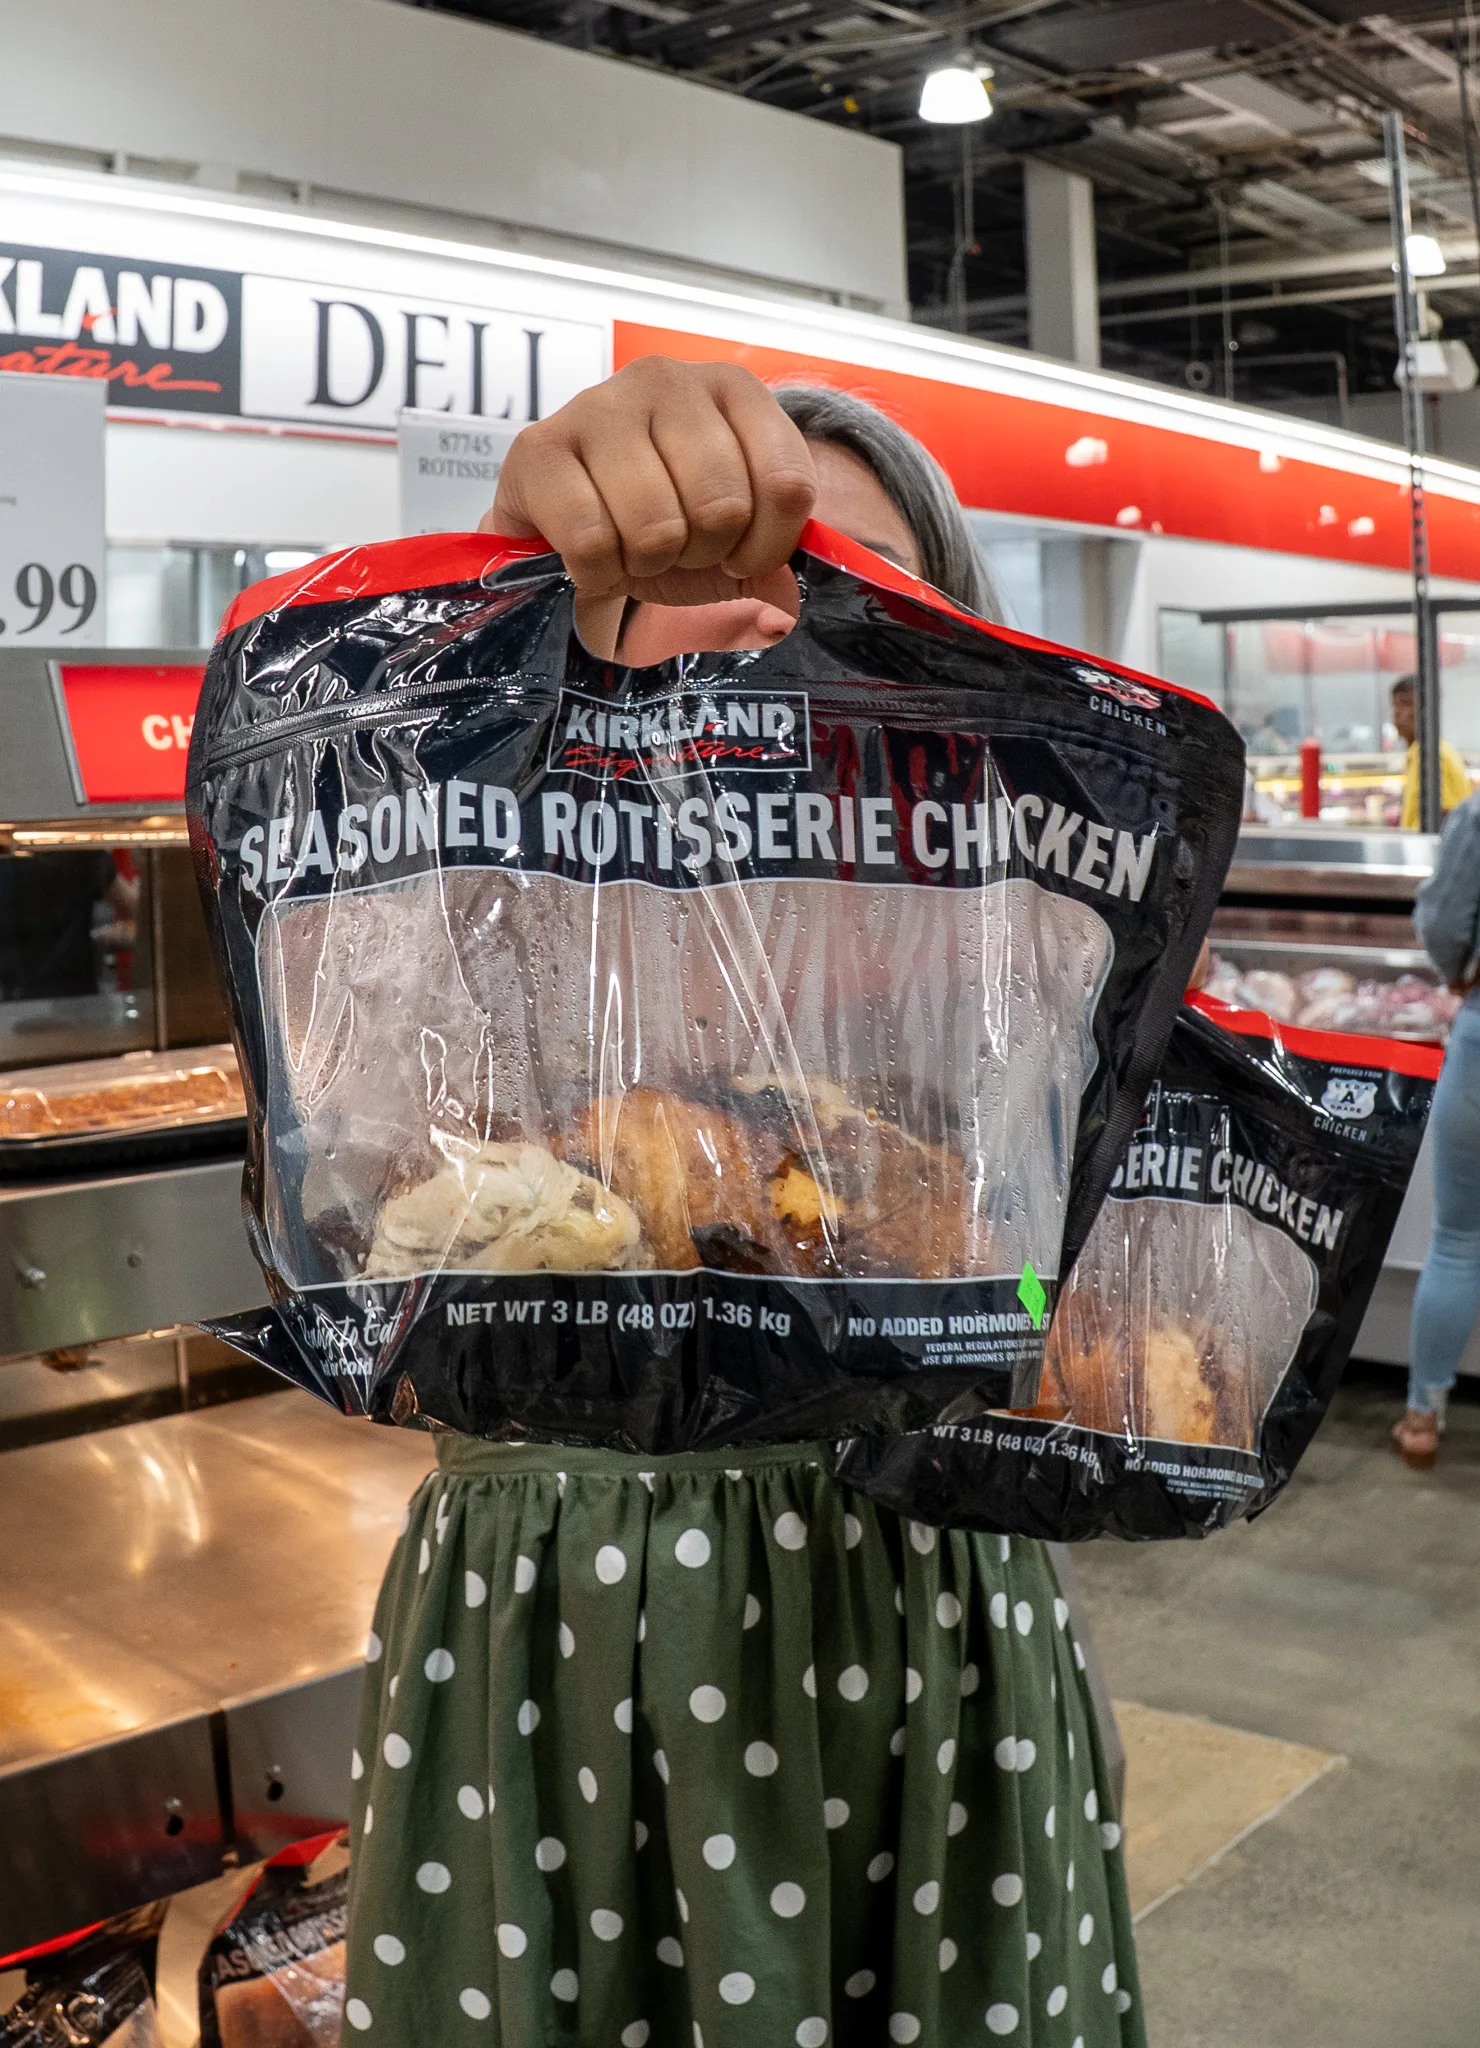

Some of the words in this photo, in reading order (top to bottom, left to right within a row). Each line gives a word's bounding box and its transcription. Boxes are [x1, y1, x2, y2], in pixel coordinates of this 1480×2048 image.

[305, 299, 546, 424] DELI
[566, 702, 796, 750] KIRKLAND
[1089, 695, 1167, 737] CHICKEN
[240, 780, 521, 893] SEASONED
[541, 791, 896, 871] ROTISSERIE
[912, 794, 1154, 902] CHICKEN
[1340, 1091, 1355, 1104] A
[1313, 1116, 1367, 1142] CHICKEN
[1211, 1149, 1343, 1250] CHICKEN
[363, 1306, 403, 1347] Eat
[447, 1302, 497, 1326] NET
[504, 1300, 546, 1324] WT
[551, 1301, 568, 1323] 3
[575, 1301, 608, 1326] LB
[616, 1303, 655, 1332] (48
[660, 1302, 697, 1330] OZ)
[702, 1297, 752, 1328] 1.36
[759, 1306, 791, 1337] kg
[848, 1317, 876, 1336] NO
[880, 1317, 943, 1336] ADDED
[948, 1312, 1032, 1334] HORMONES
[922, 1354, 940, 1365] USE
[942, 1354, 954, 1364] OF
[956, 1352, 1005, 1364] HORMONES
[925, 1342, 963, 1353] FEDERAL
[965, 1339, 1018, 1351] REGULATIONS
[339, 1357, 374, 1377] Cold
[933, 1425, 957, 1438] WT
[960, 1427, 970, 1442] 3
[974, 1429, 993, 1445] LB
[996, 1433, 1021, 1451] (48
[1023, 1435, 1046, 1456] OZ)
[1049, 1441, 1078, 1460] 1.36
[1079, 1447, 1097, 1468] kg
[1124, 1459, 1141, 1471] NO
[1143, 1460, 1181, 1476] ADDED
